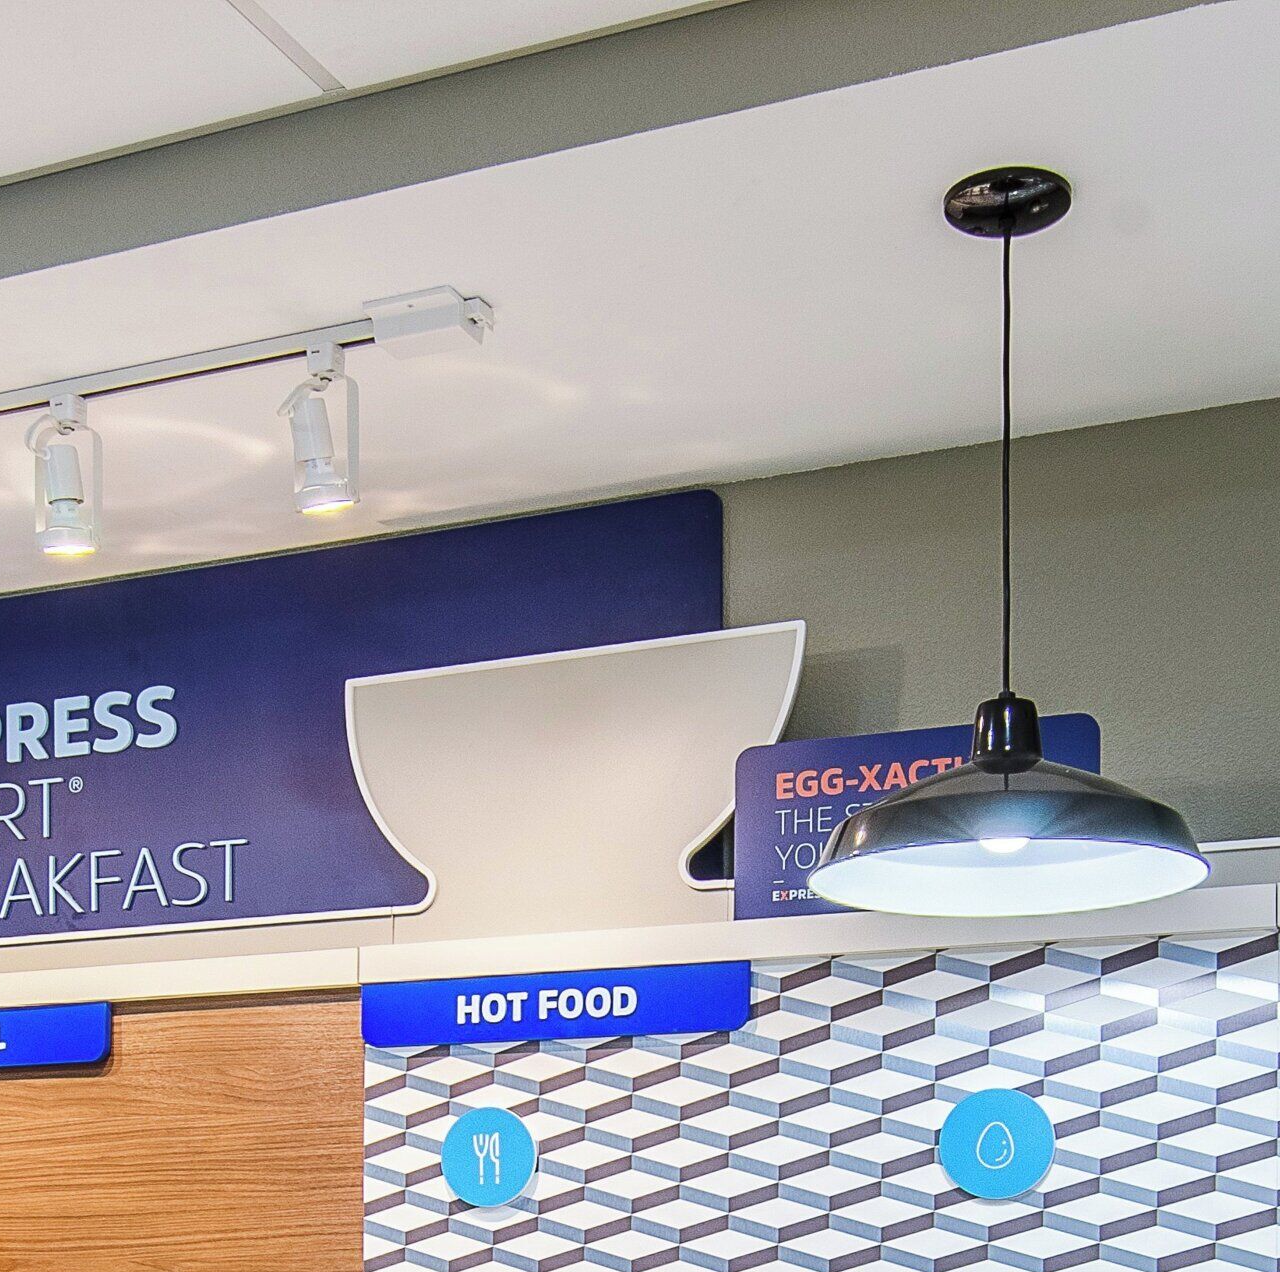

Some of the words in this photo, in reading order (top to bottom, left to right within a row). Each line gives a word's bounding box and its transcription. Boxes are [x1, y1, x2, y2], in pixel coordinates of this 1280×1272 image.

[775, 806, 832, 835] THE
[456, 992, 528, 1025] HOT
[538, 986, 638, 1020] FOOD
